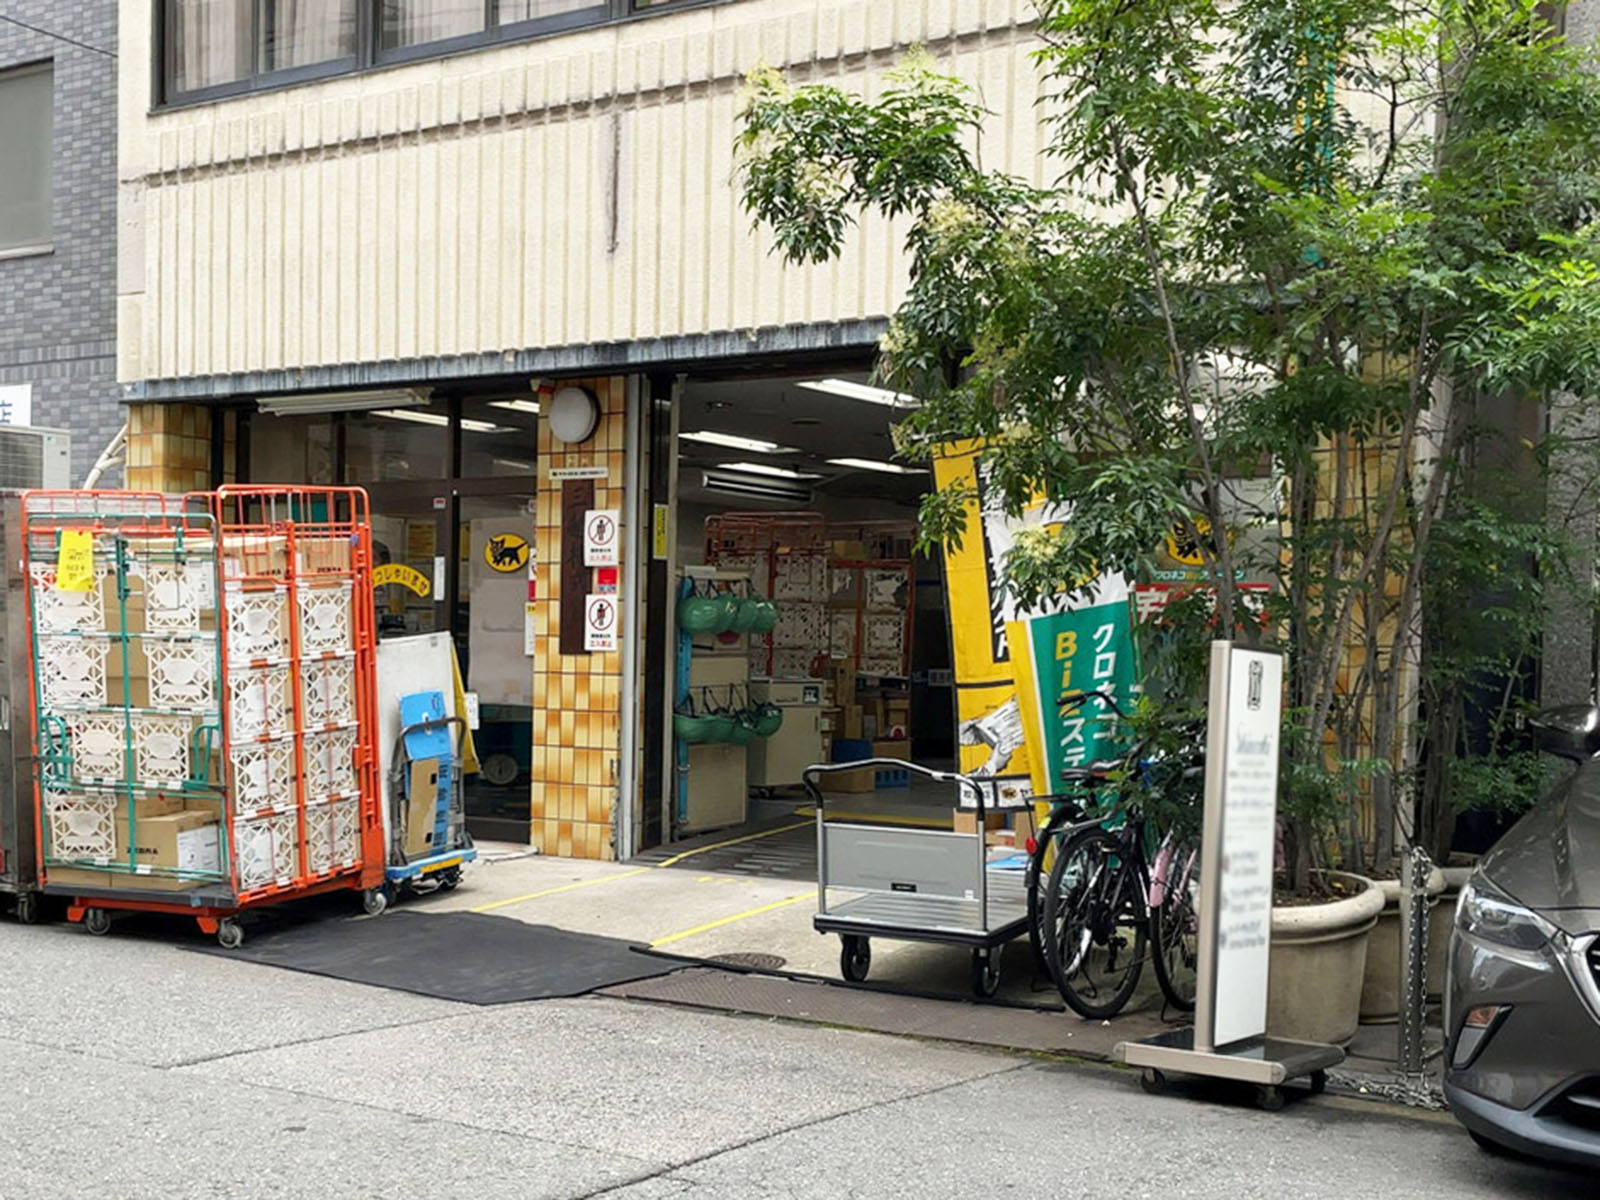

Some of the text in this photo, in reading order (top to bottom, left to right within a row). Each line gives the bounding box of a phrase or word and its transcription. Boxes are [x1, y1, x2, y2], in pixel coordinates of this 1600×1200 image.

[372, 567, 428, 593] っしゃいませ
